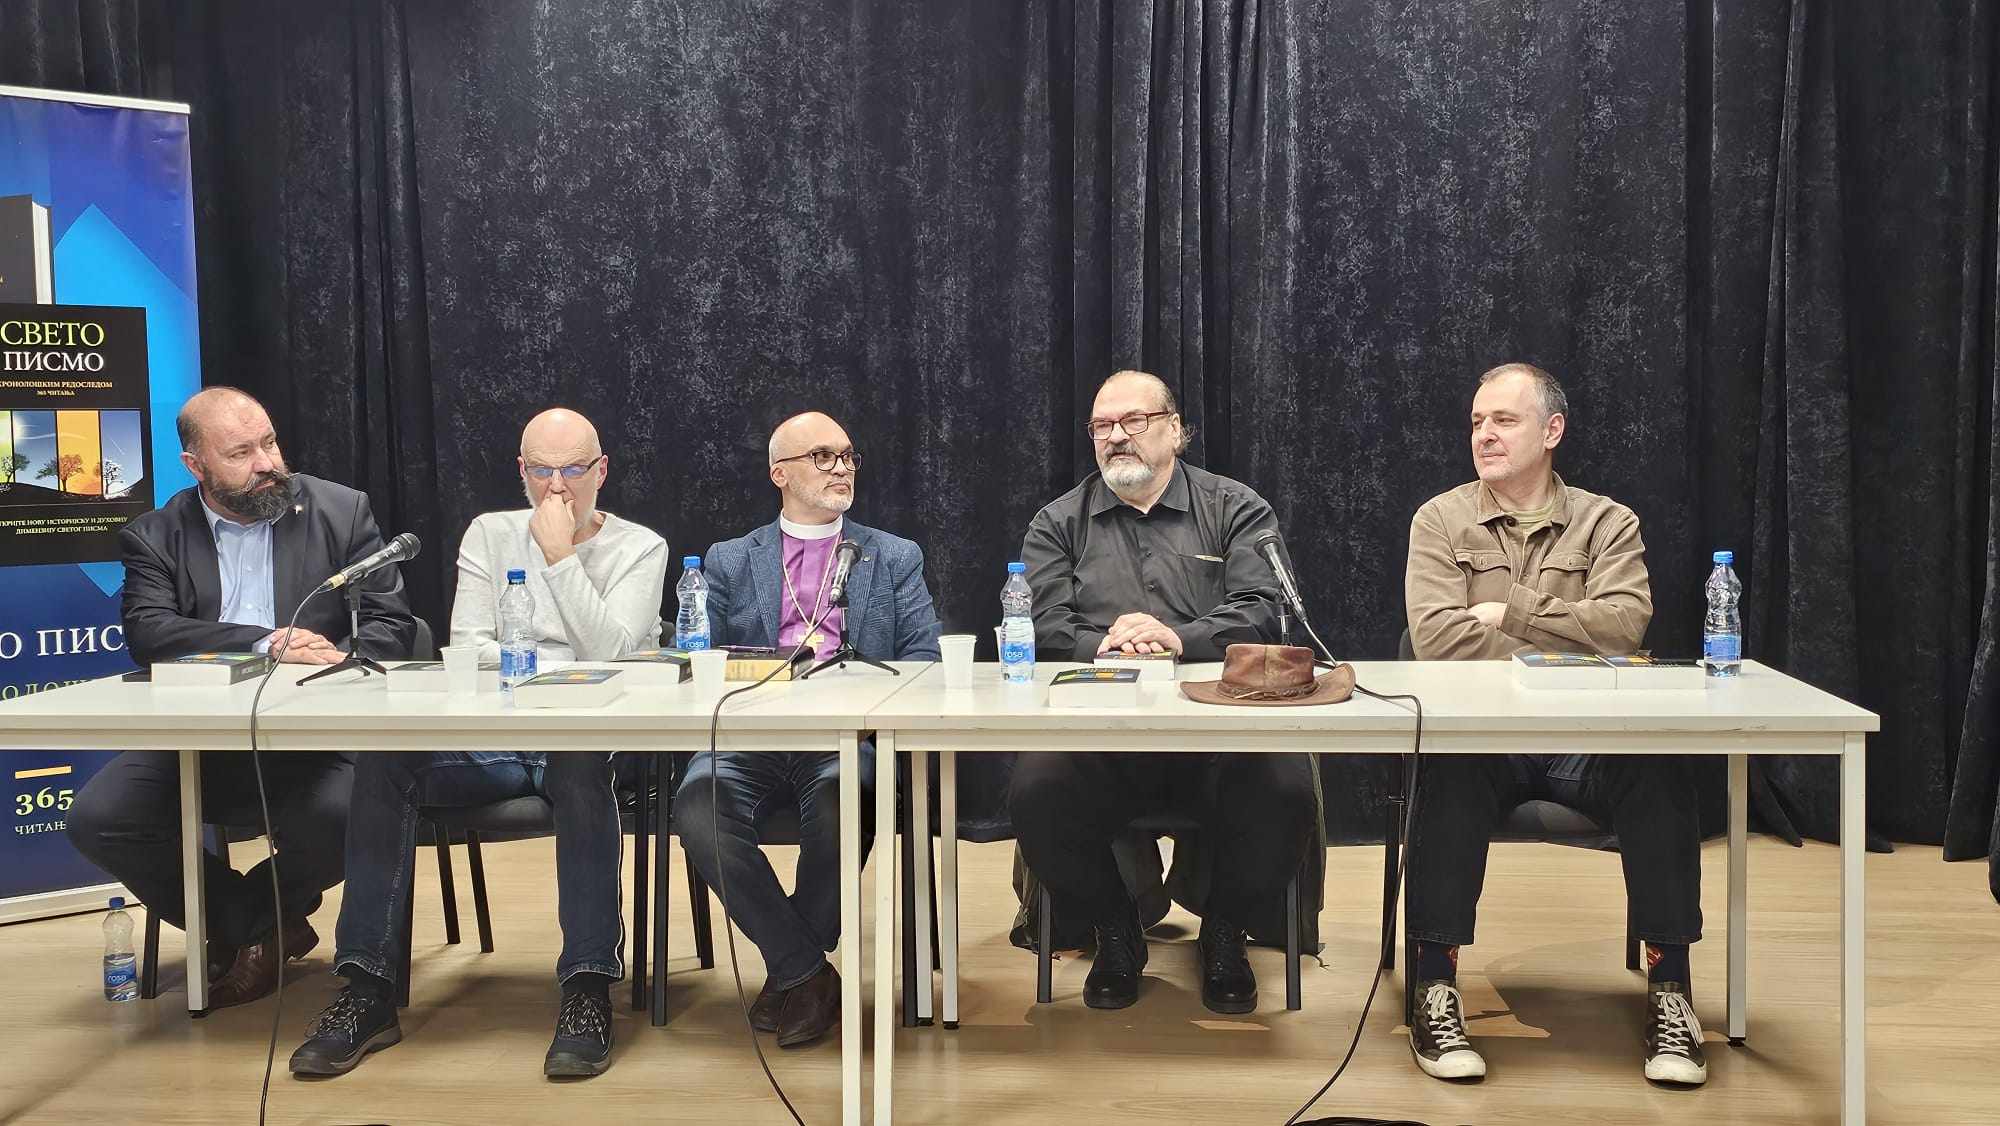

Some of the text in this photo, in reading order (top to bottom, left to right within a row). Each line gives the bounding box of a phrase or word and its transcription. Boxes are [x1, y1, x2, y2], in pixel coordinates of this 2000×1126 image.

[0, 320, 105, 347] СВЕТО
[3, 351, 105, 372] ПИСМО
[62, 380, 113, 389] РЕДОСЛЕДОМ
[36, 625, 129, 657] ПИС
[15, 786, 75, 816] 365
